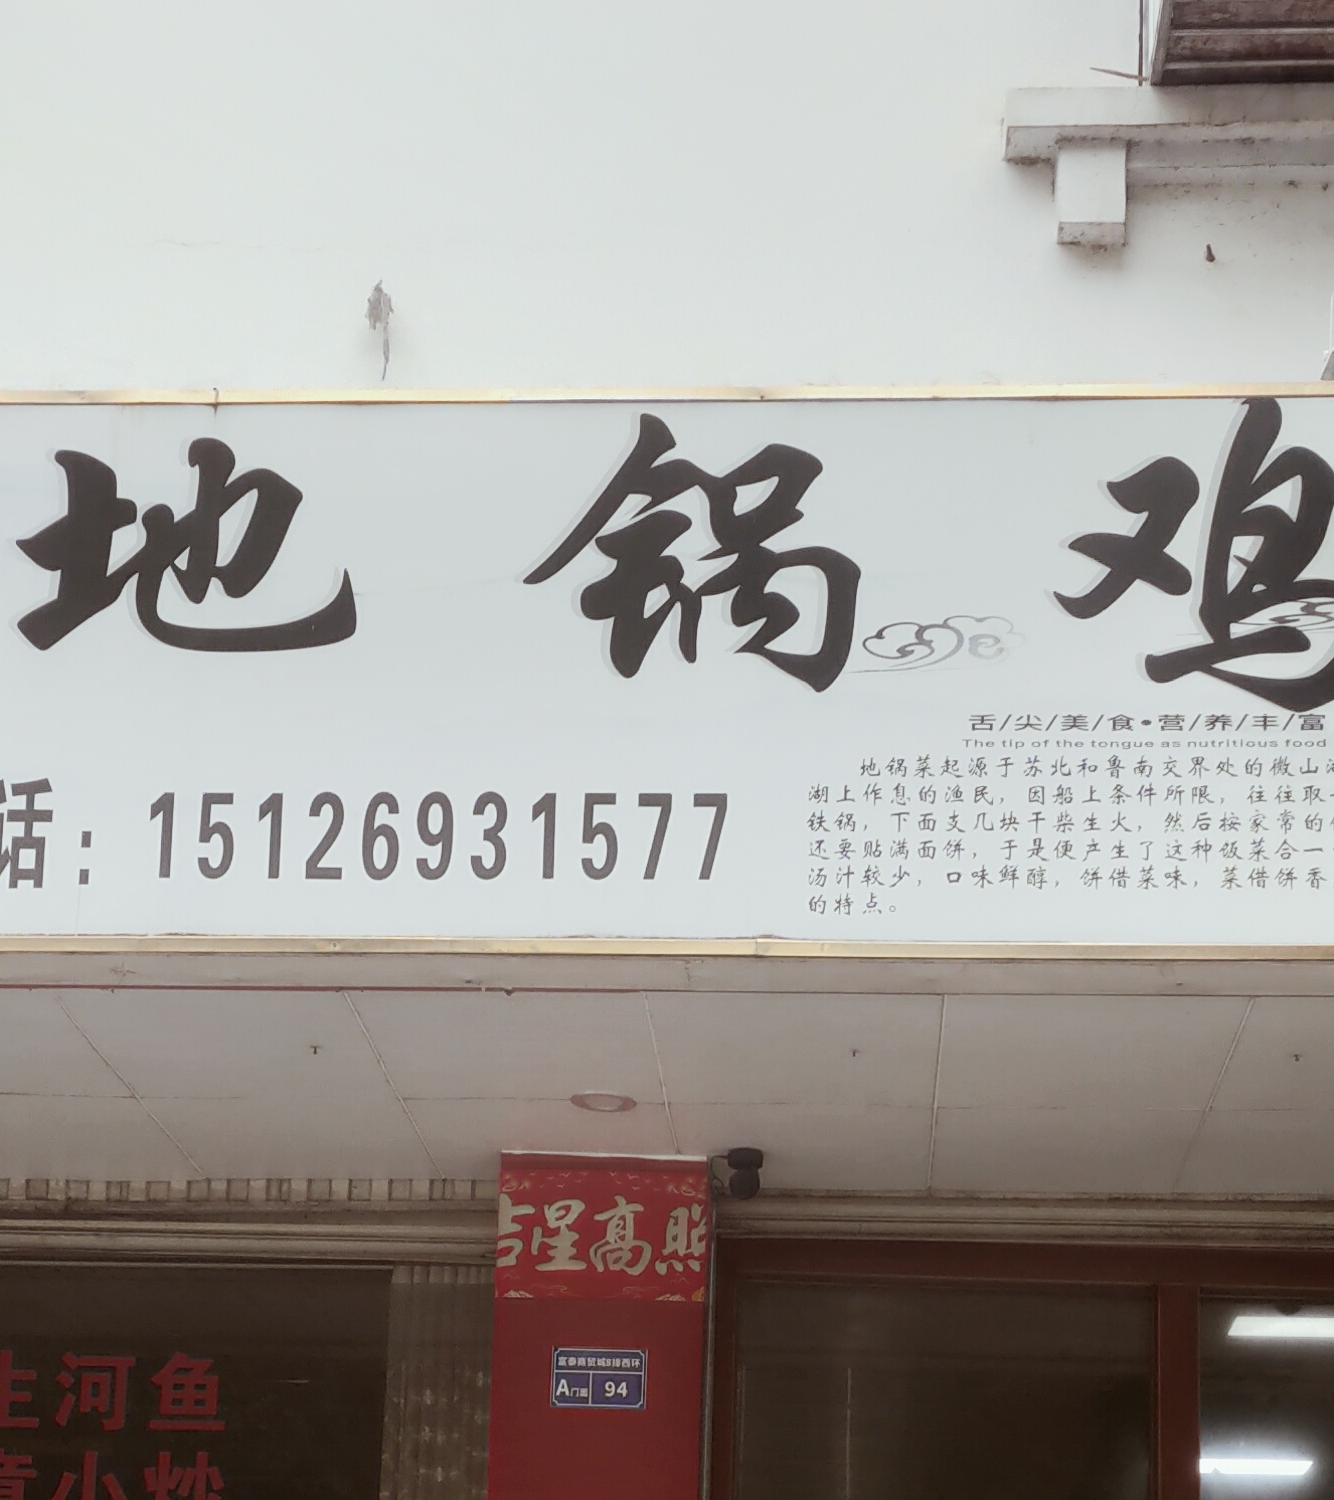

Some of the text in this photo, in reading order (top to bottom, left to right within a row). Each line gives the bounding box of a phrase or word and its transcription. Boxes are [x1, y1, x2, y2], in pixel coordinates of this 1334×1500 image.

[962, 739, 995, 748] The
[1002, 739, 1025, 749] tip
[1031, 739, 1050, 748] of
[1056, 739, 1085, 748] the
[1091, 739, 1155, 749] tongue
[1285, 739, 1327, 748] food
[808, 893, 898, 915] 的特点。
[604, 1381, 628, 1398] 94
